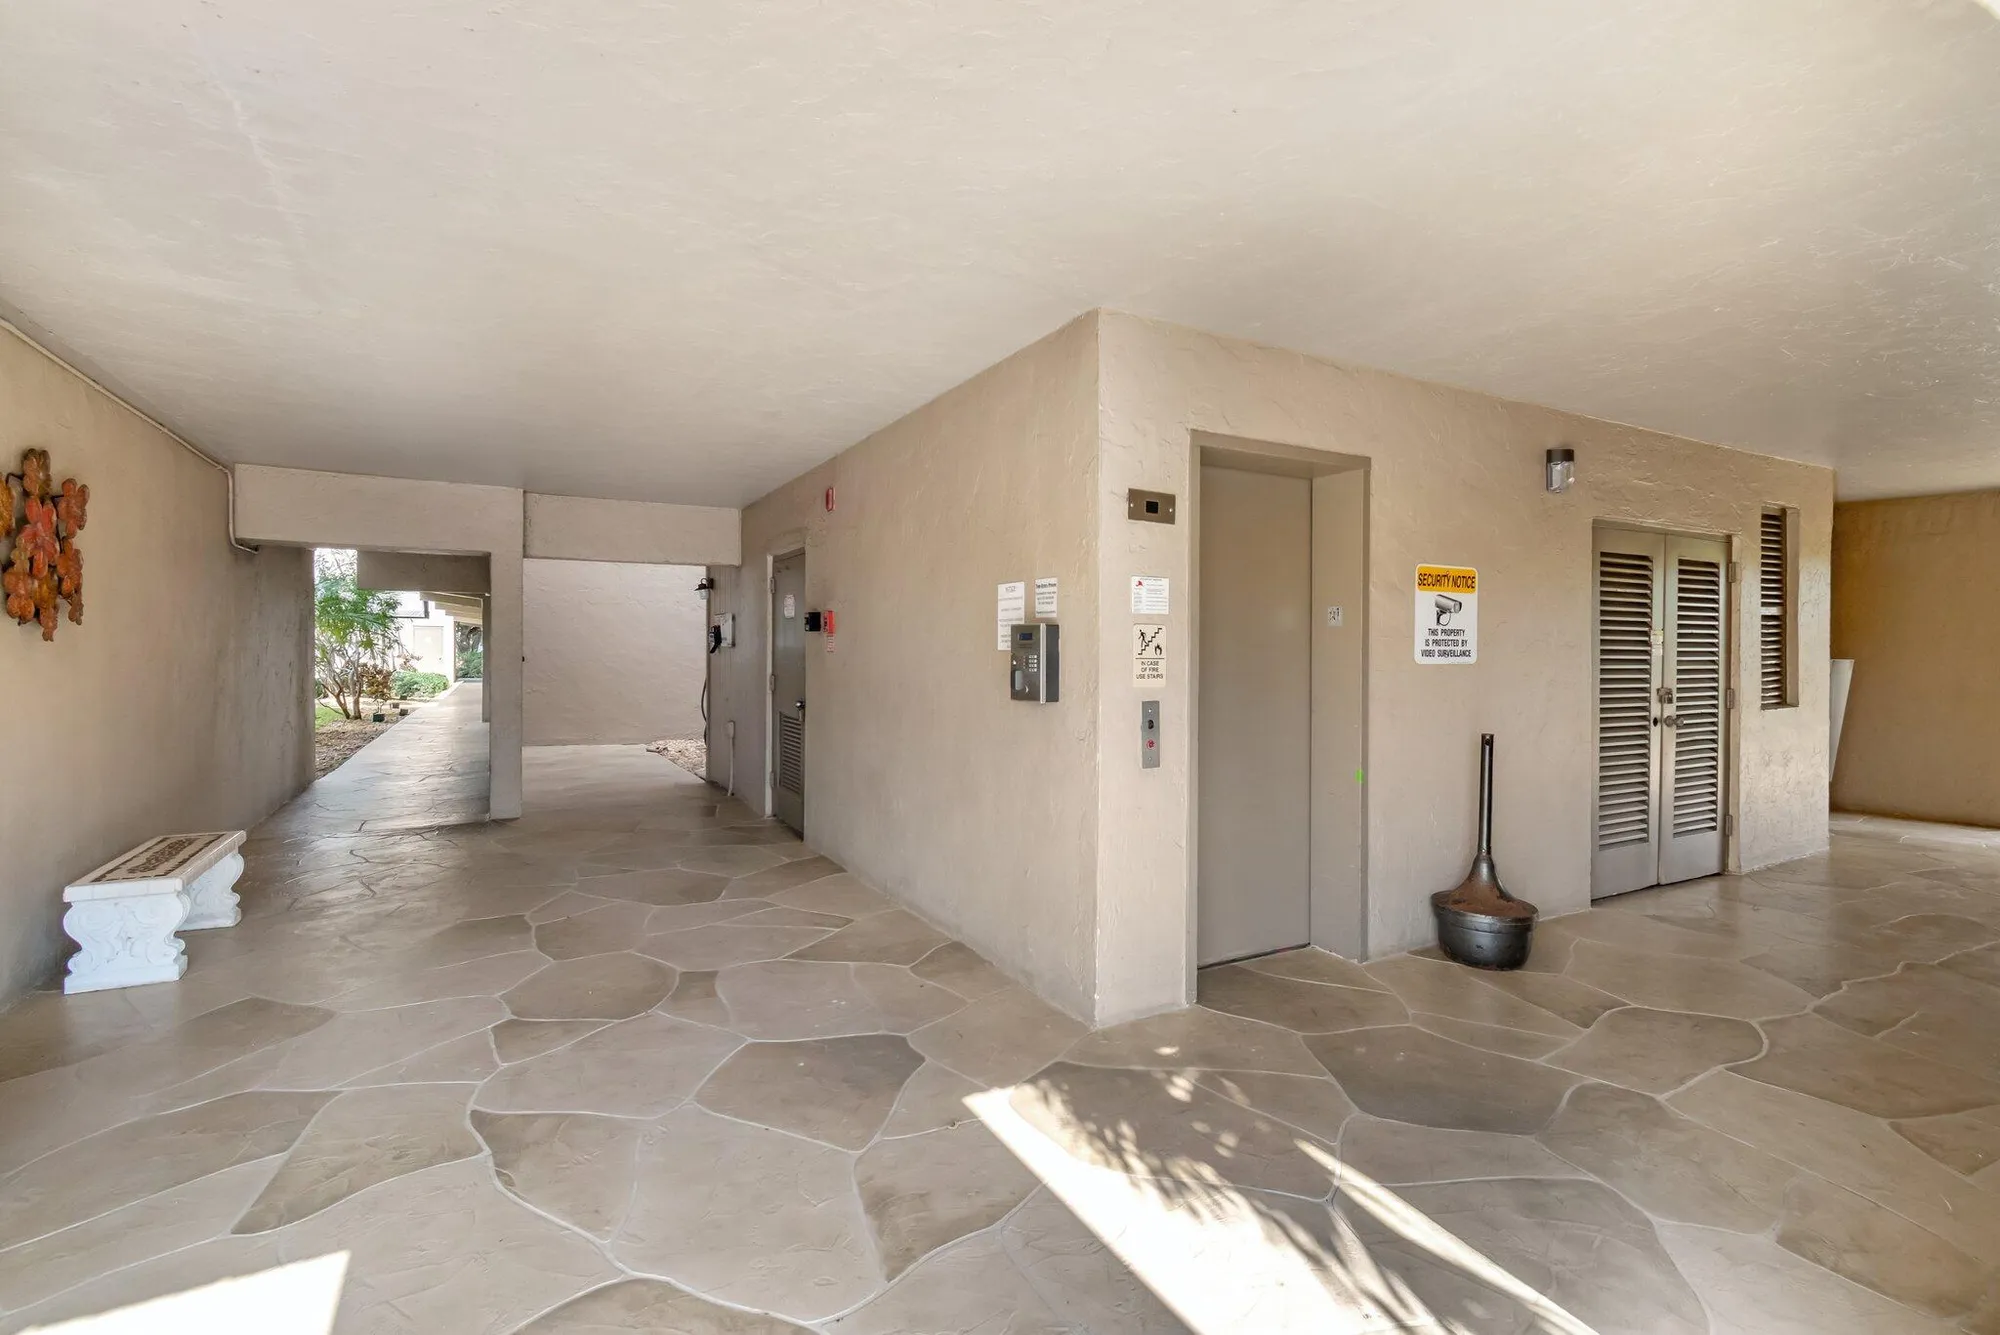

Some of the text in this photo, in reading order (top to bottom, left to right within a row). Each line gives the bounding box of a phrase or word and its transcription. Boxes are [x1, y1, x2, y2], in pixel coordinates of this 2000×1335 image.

[1418, 573, 1475, 588] SECURITY NOTICE
[1428, 628, 1465, 636] THIS PROPERTY
[1437, 650, 1472, 658] SURVEILLANCE
